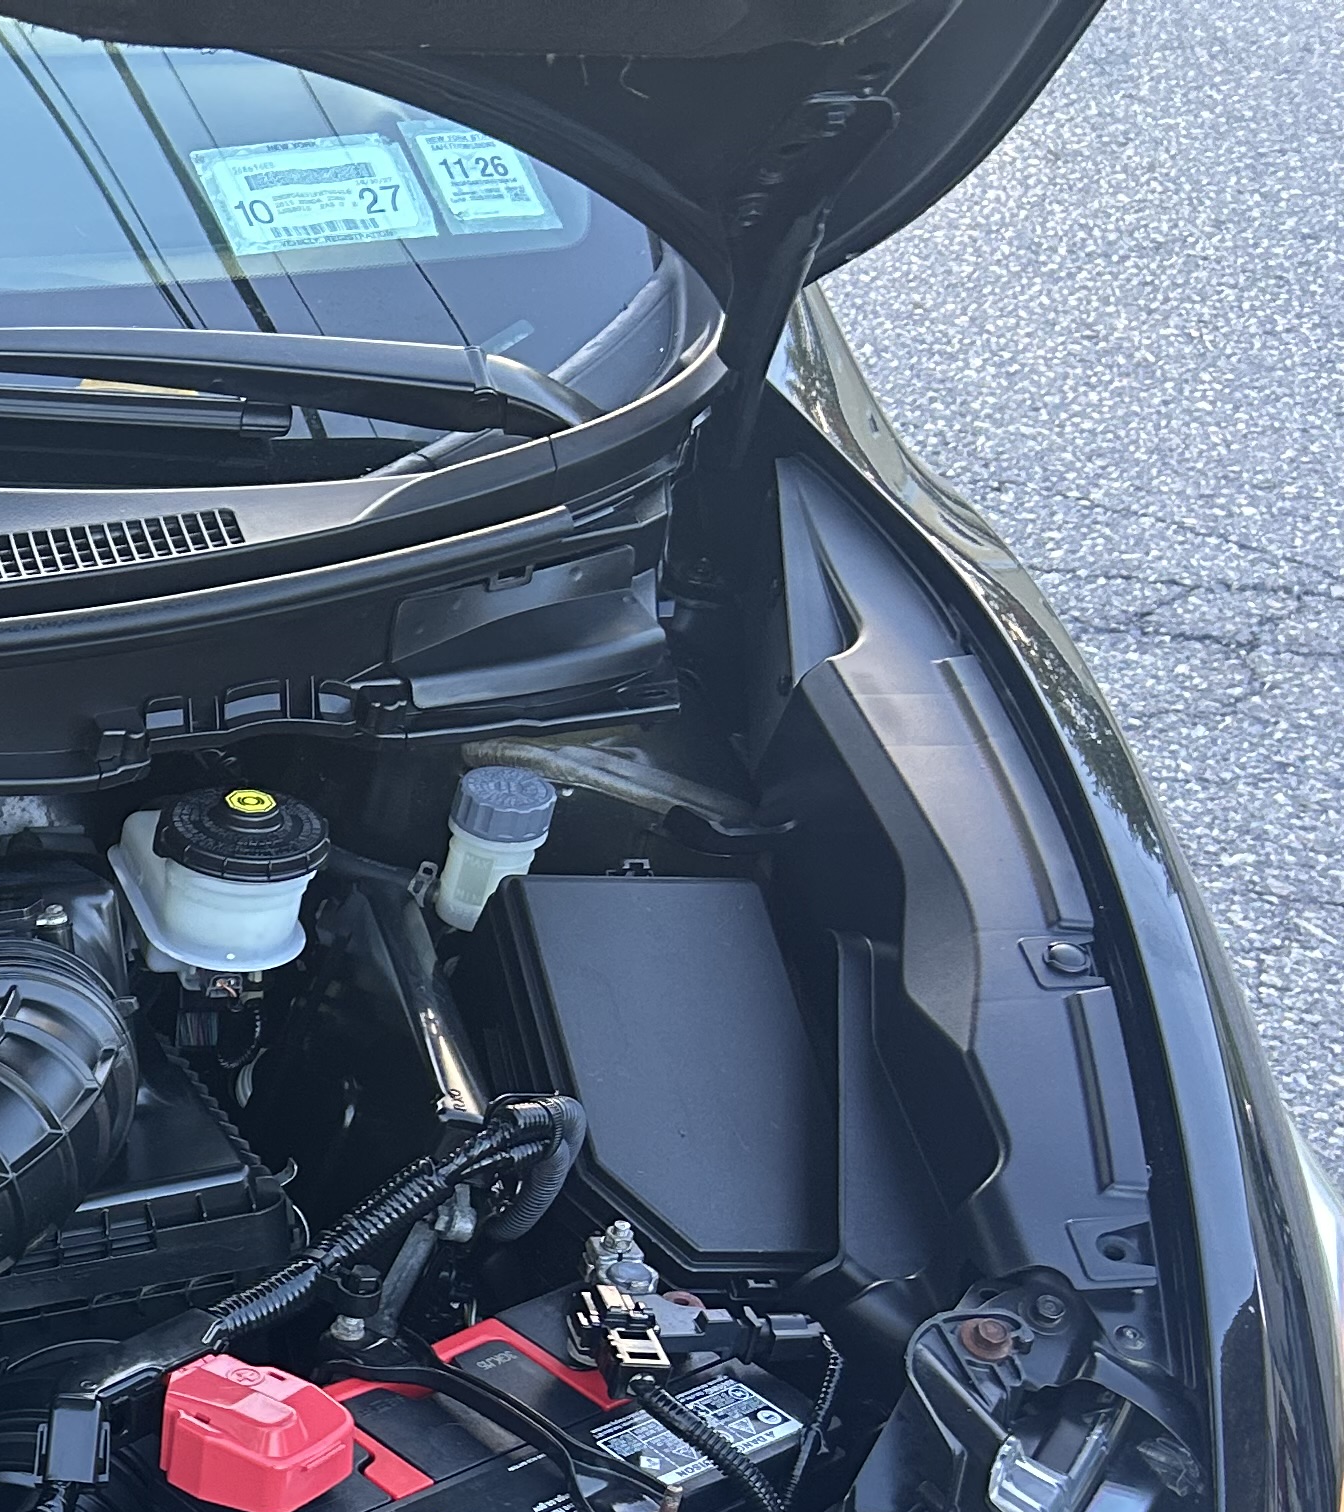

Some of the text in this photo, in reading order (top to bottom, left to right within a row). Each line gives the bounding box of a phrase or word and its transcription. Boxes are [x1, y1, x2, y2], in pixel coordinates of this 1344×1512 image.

[265, 141, 317, 152] NEW YORK
[438, 155, 509, 180] 11 26
[358, 184, 400, 215] 27
[233, 199, 275, 227] 10
